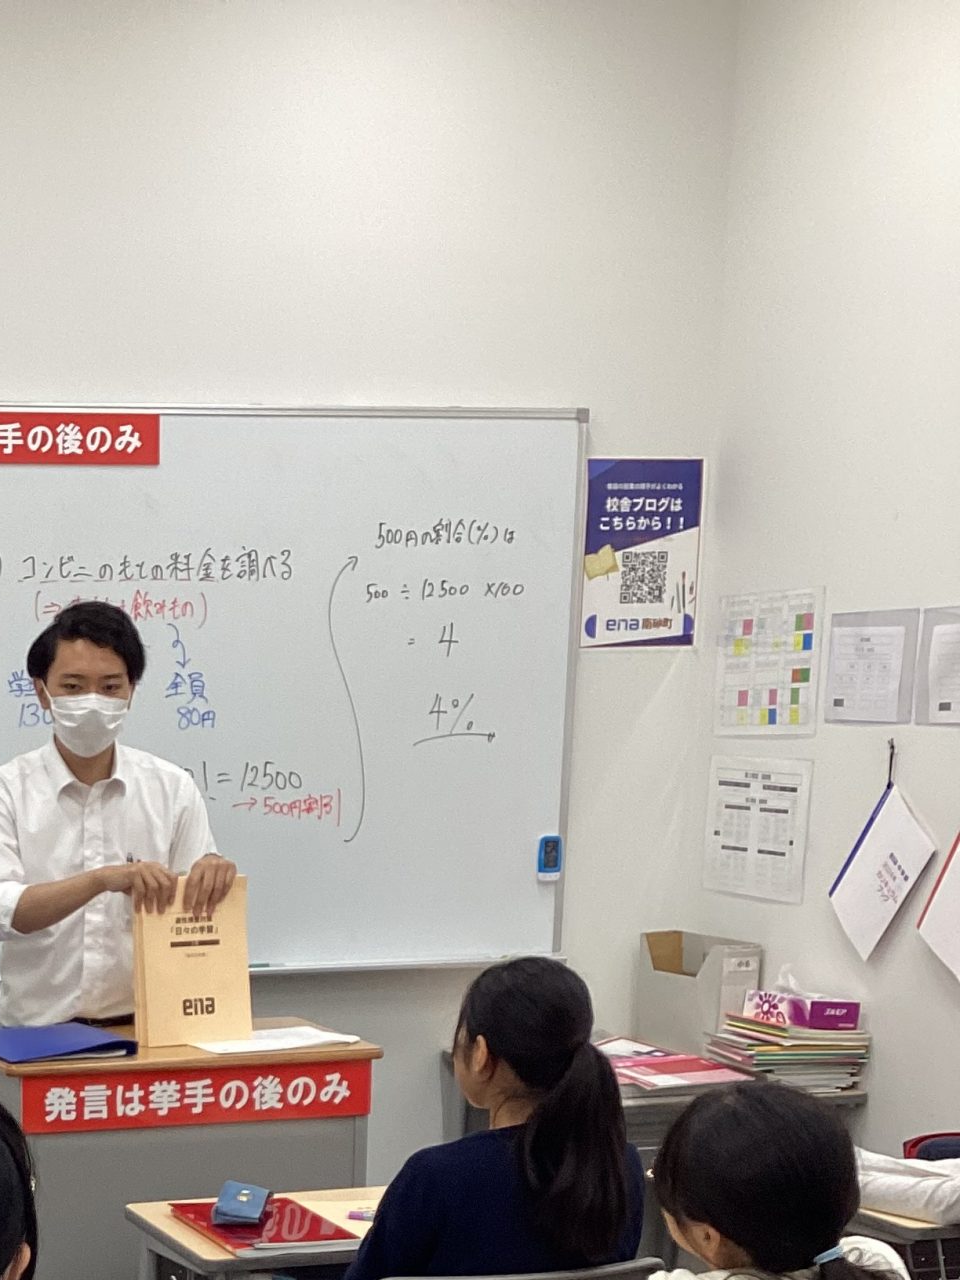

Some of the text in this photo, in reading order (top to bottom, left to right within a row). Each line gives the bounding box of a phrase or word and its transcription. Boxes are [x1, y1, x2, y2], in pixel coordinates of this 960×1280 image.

[605, 496, 683, 513] 校舎ブログは
[605, 618, 640, 631] ena
[182, 997, 216, 1016] ena
[43, 1071, 351, 1123] 発言は挙手の後のみ
